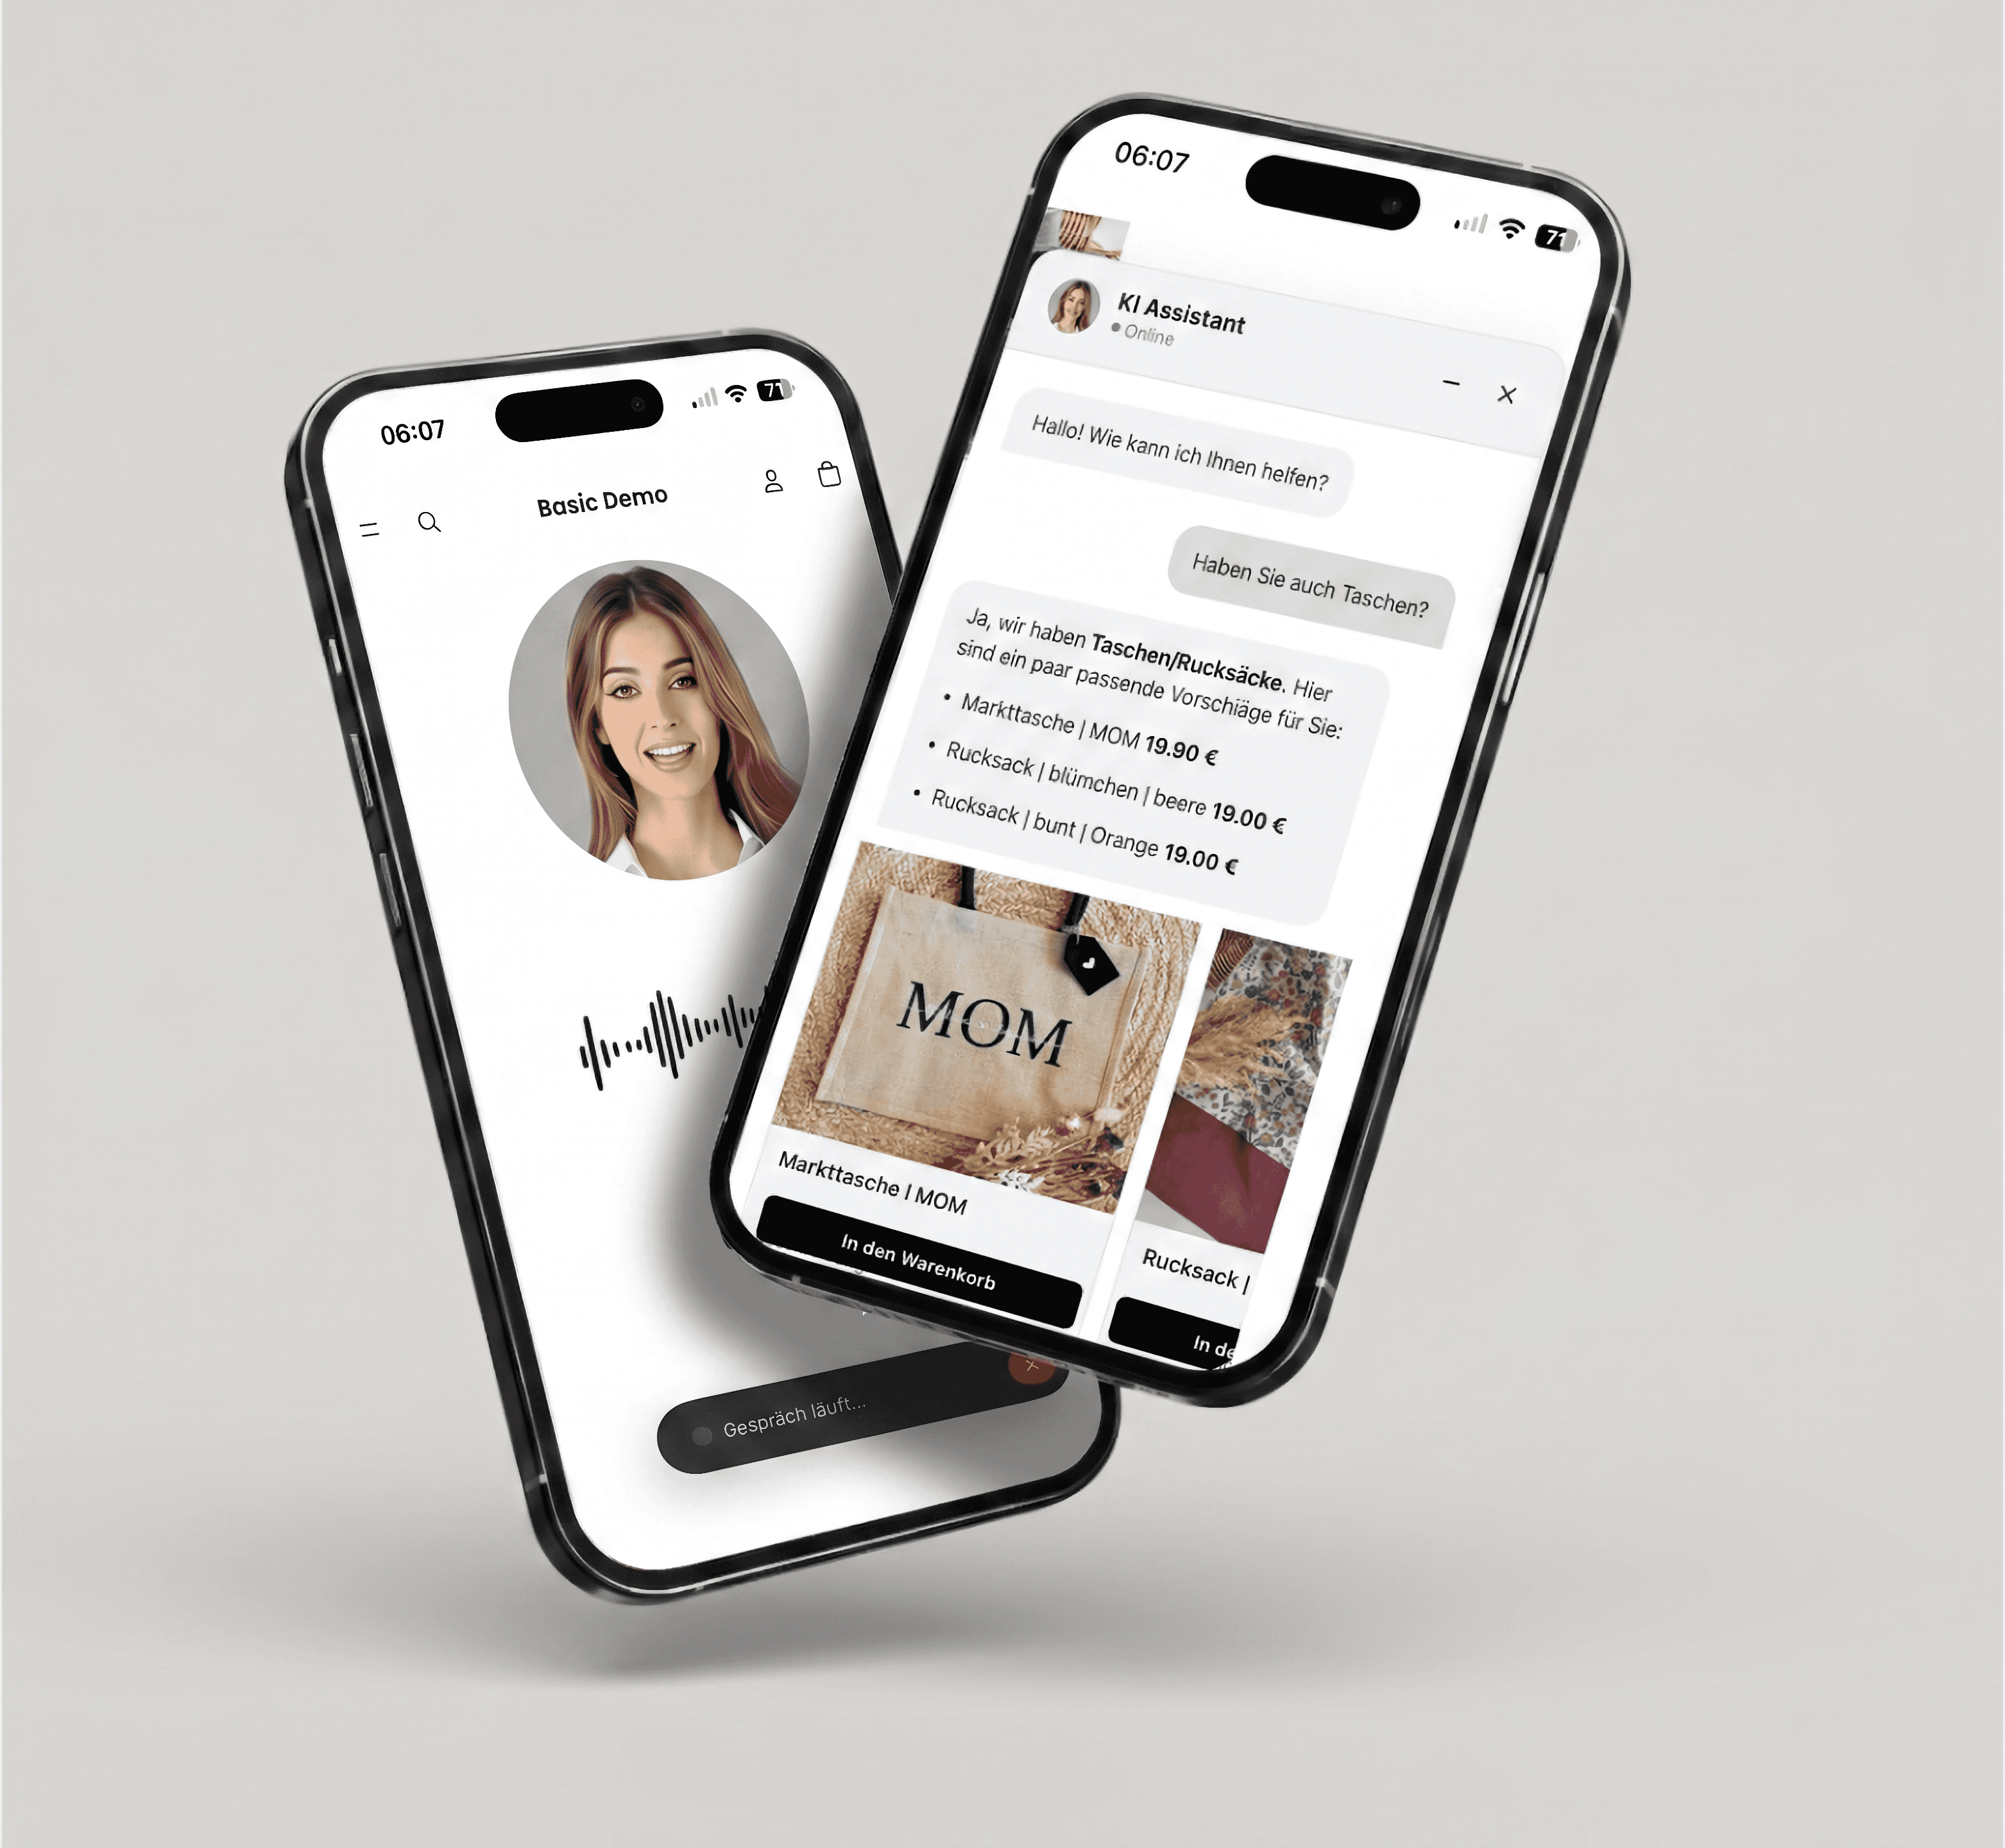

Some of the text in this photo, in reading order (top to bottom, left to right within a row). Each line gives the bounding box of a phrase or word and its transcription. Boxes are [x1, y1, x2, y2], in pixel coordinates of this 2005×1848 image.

[1116, 142, 1190, 173] 06:07
[1546, 230, 1566, 247] 71
[1118, 293, 1246, 334] KI Assistant
[1125, 324, 1174, 346] Online
[764, 382, 784, 398] 71
[381, 420, 443, 445] 06:07
[1032, 415, 1329, 491] Hallo! Wie kann ich Ihnen helfen?
[538, 489, 667, 517] Basic Demo
[1193, 553, 1429, 618] Haben Sie auch Taschen?
[966, 608, 1333, 701] Ja, wir haben Taschen/Rucksäcke. Hier
[957, 642, 996, 662] sind
[1000, 652, 1026, 669] ein
[1029, 659, 1073, 678] paar
[1076, 669, 1165, 699] passende
[1277, 710, 1304, 730] für
[1308, 717, 1342, 739] Sie:
[962, 693, 1074, 733] Markttasche
[1089, 723, 1140, 749] MOM
[1147, 736, 1199, 762] 19.90
[1204, 749, 1219, 766] €
[946, 741, 1035, 776] Rucksack
[1049, 764, 1138, 801] blümchen
[1154, 788, 1206, 815] beere
[1214, 803, 1267, 830] 19.00
[1272, 818, 1287, 834] €
[932, 789, 1020, 825] Rucksack
[1033, 812, 1076, 838] bunt
[1091, 826, 1158, 857] Orange
[1166, 844, 1218, 870] 19.00
[1225, 859, 1239, 875] €
[897, 982, 1072, 1067] MOM
[779, 1151, 900, 1196] Markttasche
[915, 1186, 968, 1215] MOM
[841, 1234, 858, 1251] In
[863, 1241, 896, 1262] den
[903, 1251, 995, 1290] Warenkorb
[1143, 1248, 1239, 1288] Rucksack
[1193, 1335, 1210, 1352] In
[724, 1408, 806, 1437] Gespräch
